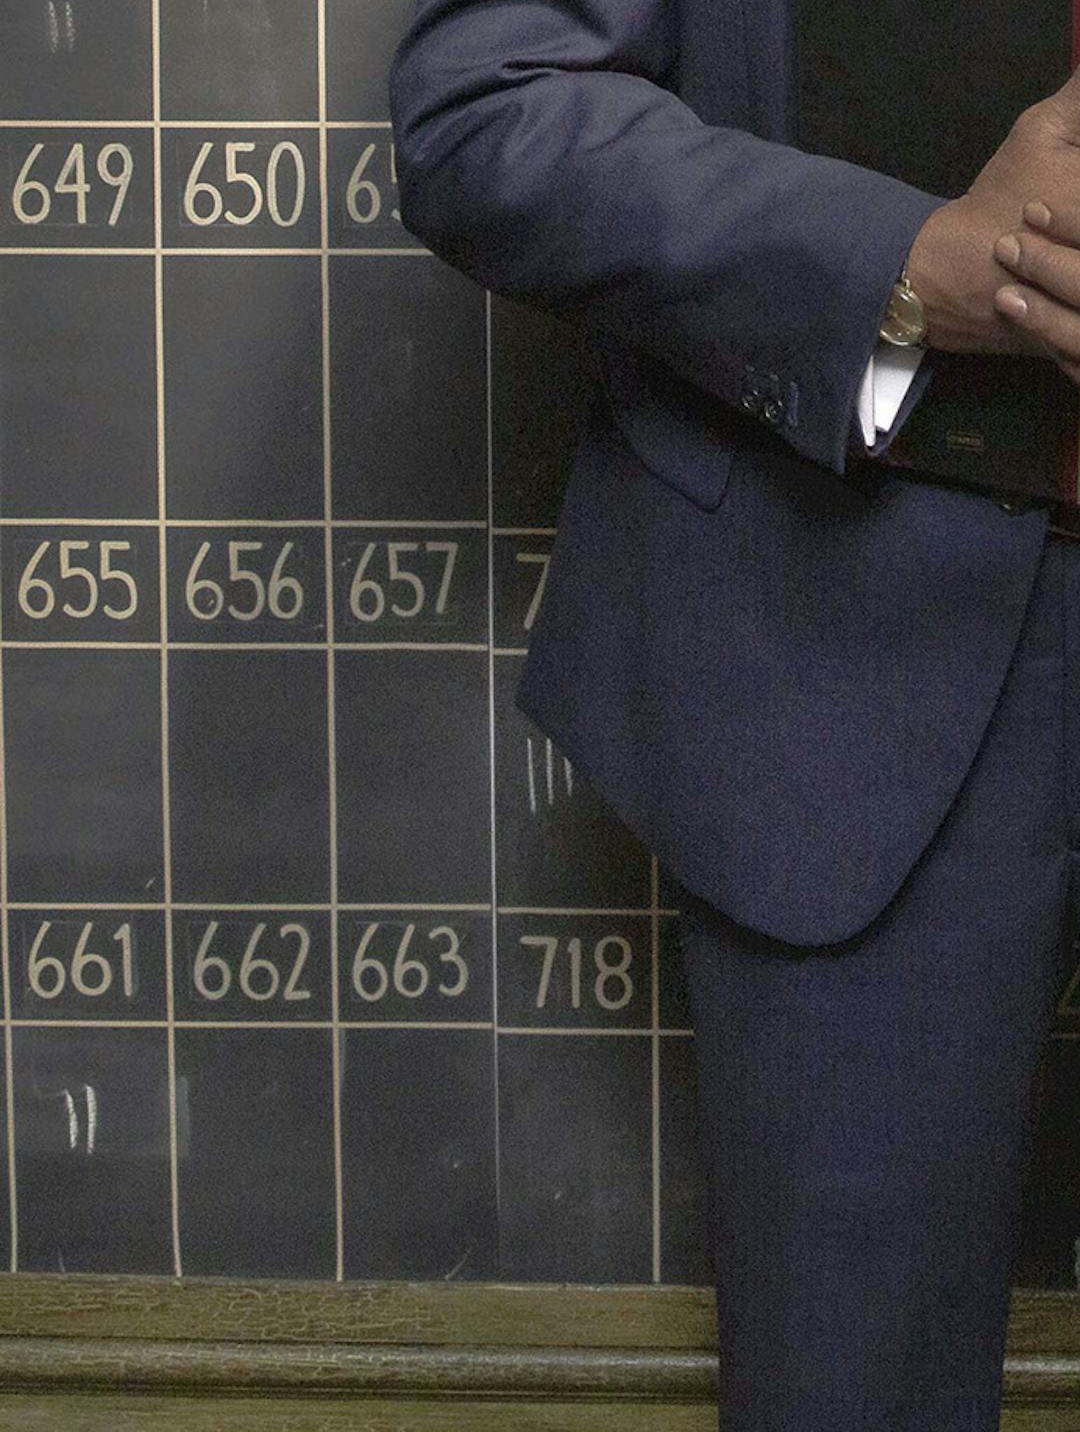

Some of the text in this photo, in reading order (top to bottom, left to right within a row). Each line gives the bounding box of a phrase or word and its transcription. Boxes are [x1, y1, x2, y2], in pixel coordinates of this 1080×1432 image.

[12, 143, 134, 226] 649
[184, 141, 305, 227] 650
[18, 540, 138, 620] 655
[185, 541, 303, 621] 656
[349, 542, 458, 622] 657
[28, 920, 133, 999] 661
[193, 920, 311, 1001] 662
[352, 922, 469, 1002] 663
[519, 935, 632, 1010] 718
